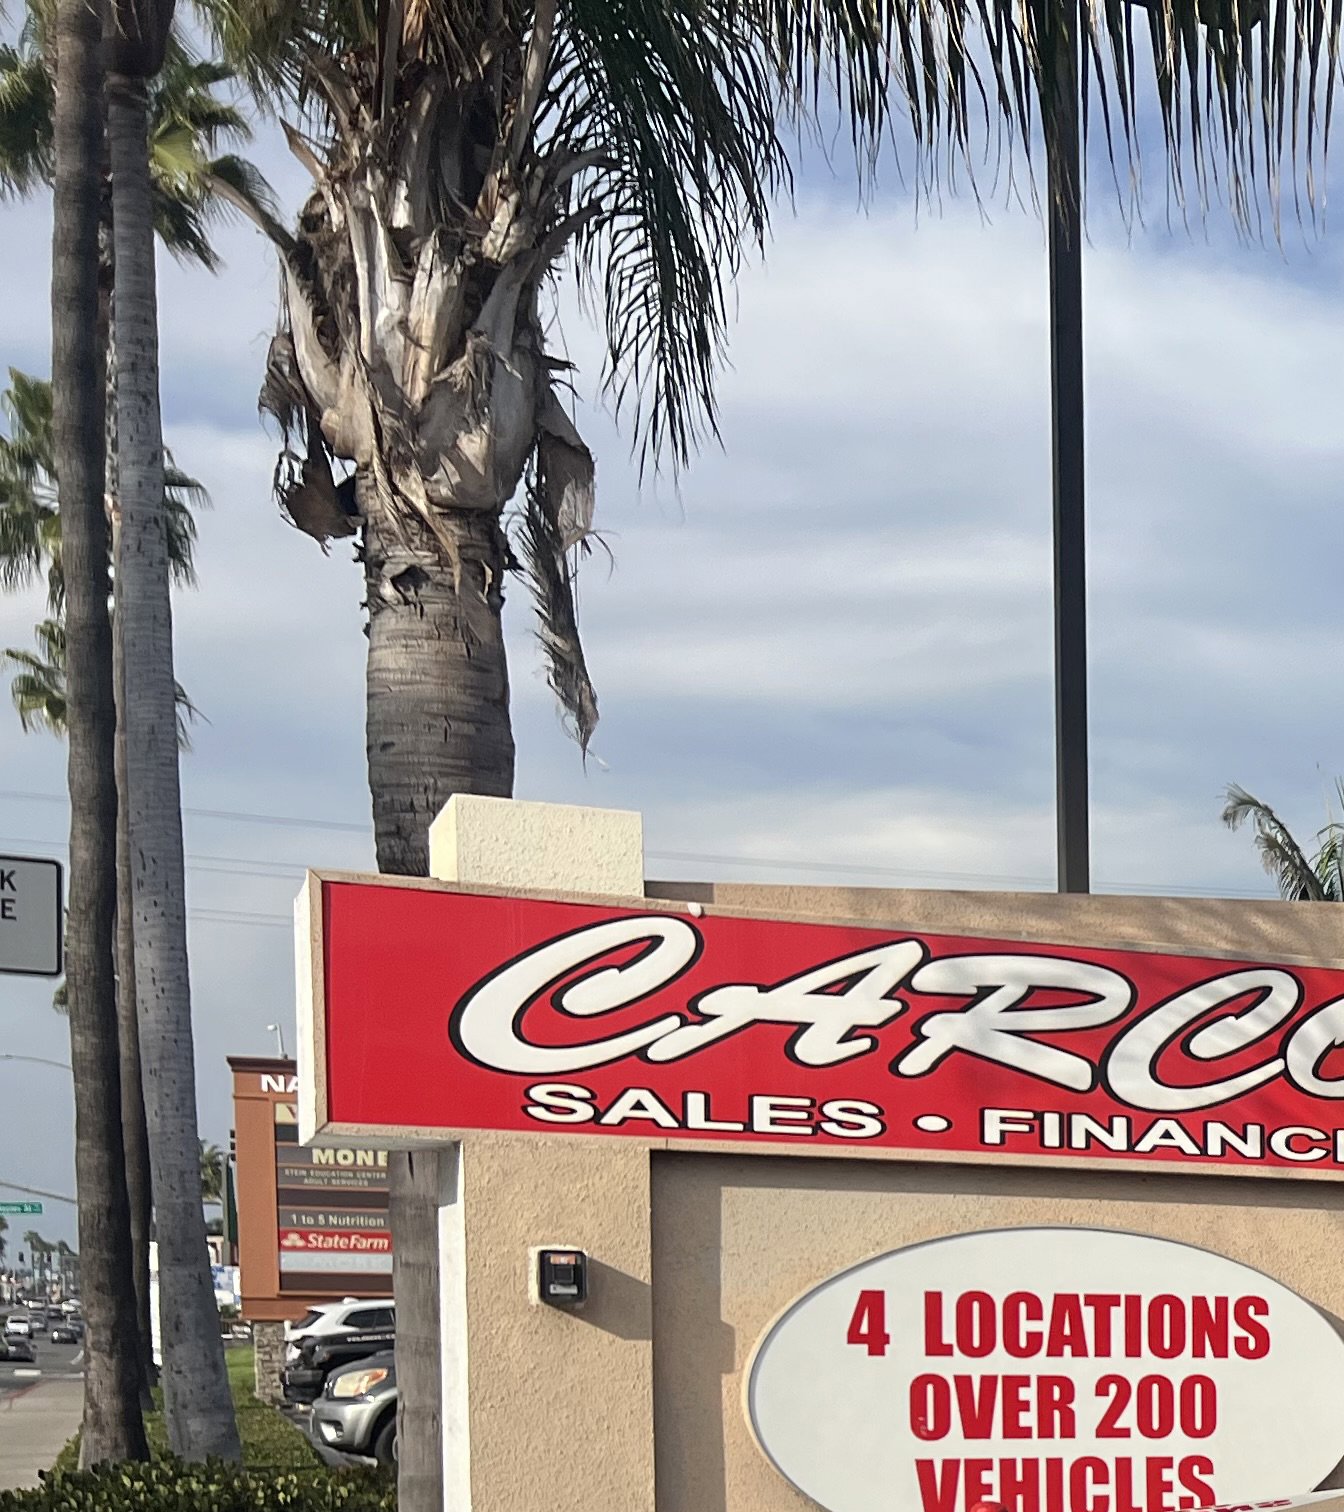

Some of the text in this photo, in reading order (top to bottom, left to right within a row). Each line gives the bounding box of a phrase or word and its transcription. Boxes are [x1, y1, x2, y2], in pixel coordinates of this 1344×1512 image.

[525, 1081, 884, 1140] SALES
[301, 1214, 314, 1225] to
[328, 1214, 385, 1227] Nutrition
[847, 1289, 1271, 1361] 4 LOCATIONS
[909, 1372, 1218, 1441] OVER 200
